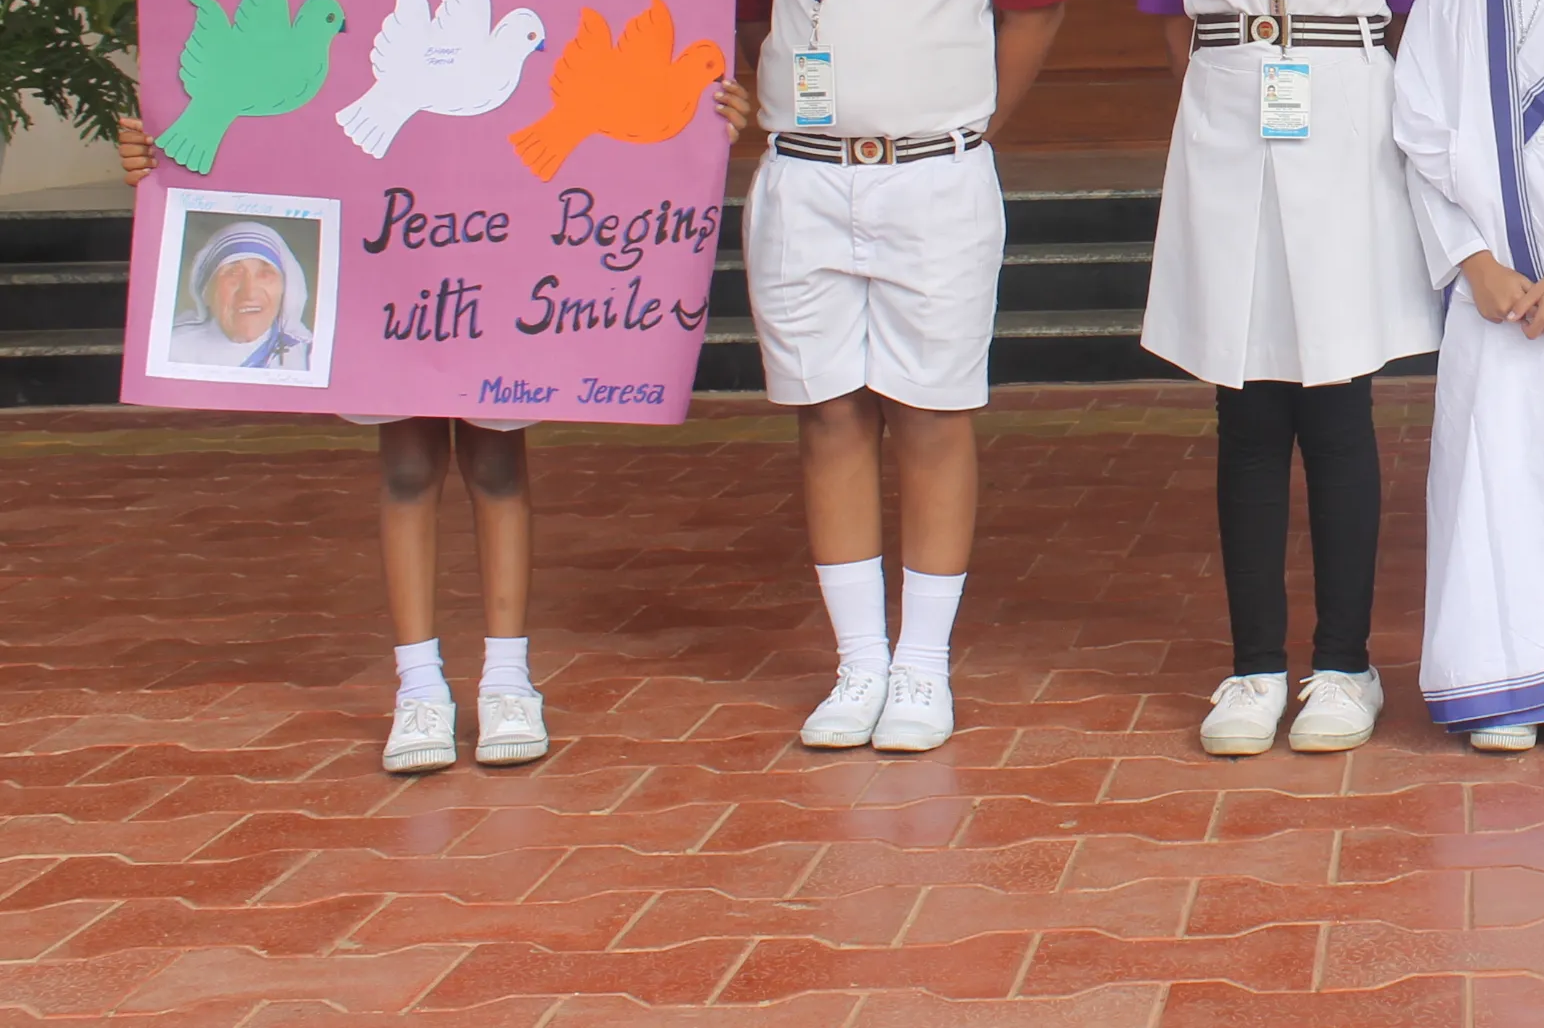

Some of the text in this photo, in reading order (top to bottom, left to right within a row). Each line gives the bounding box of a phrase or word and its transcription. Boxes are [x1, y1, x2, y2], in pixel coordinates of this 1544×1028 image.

[363, 187, 719, 271] Peace Begins
[383, 274, 663, 341] with Smile
[478, 377, 560, 404] Mother
